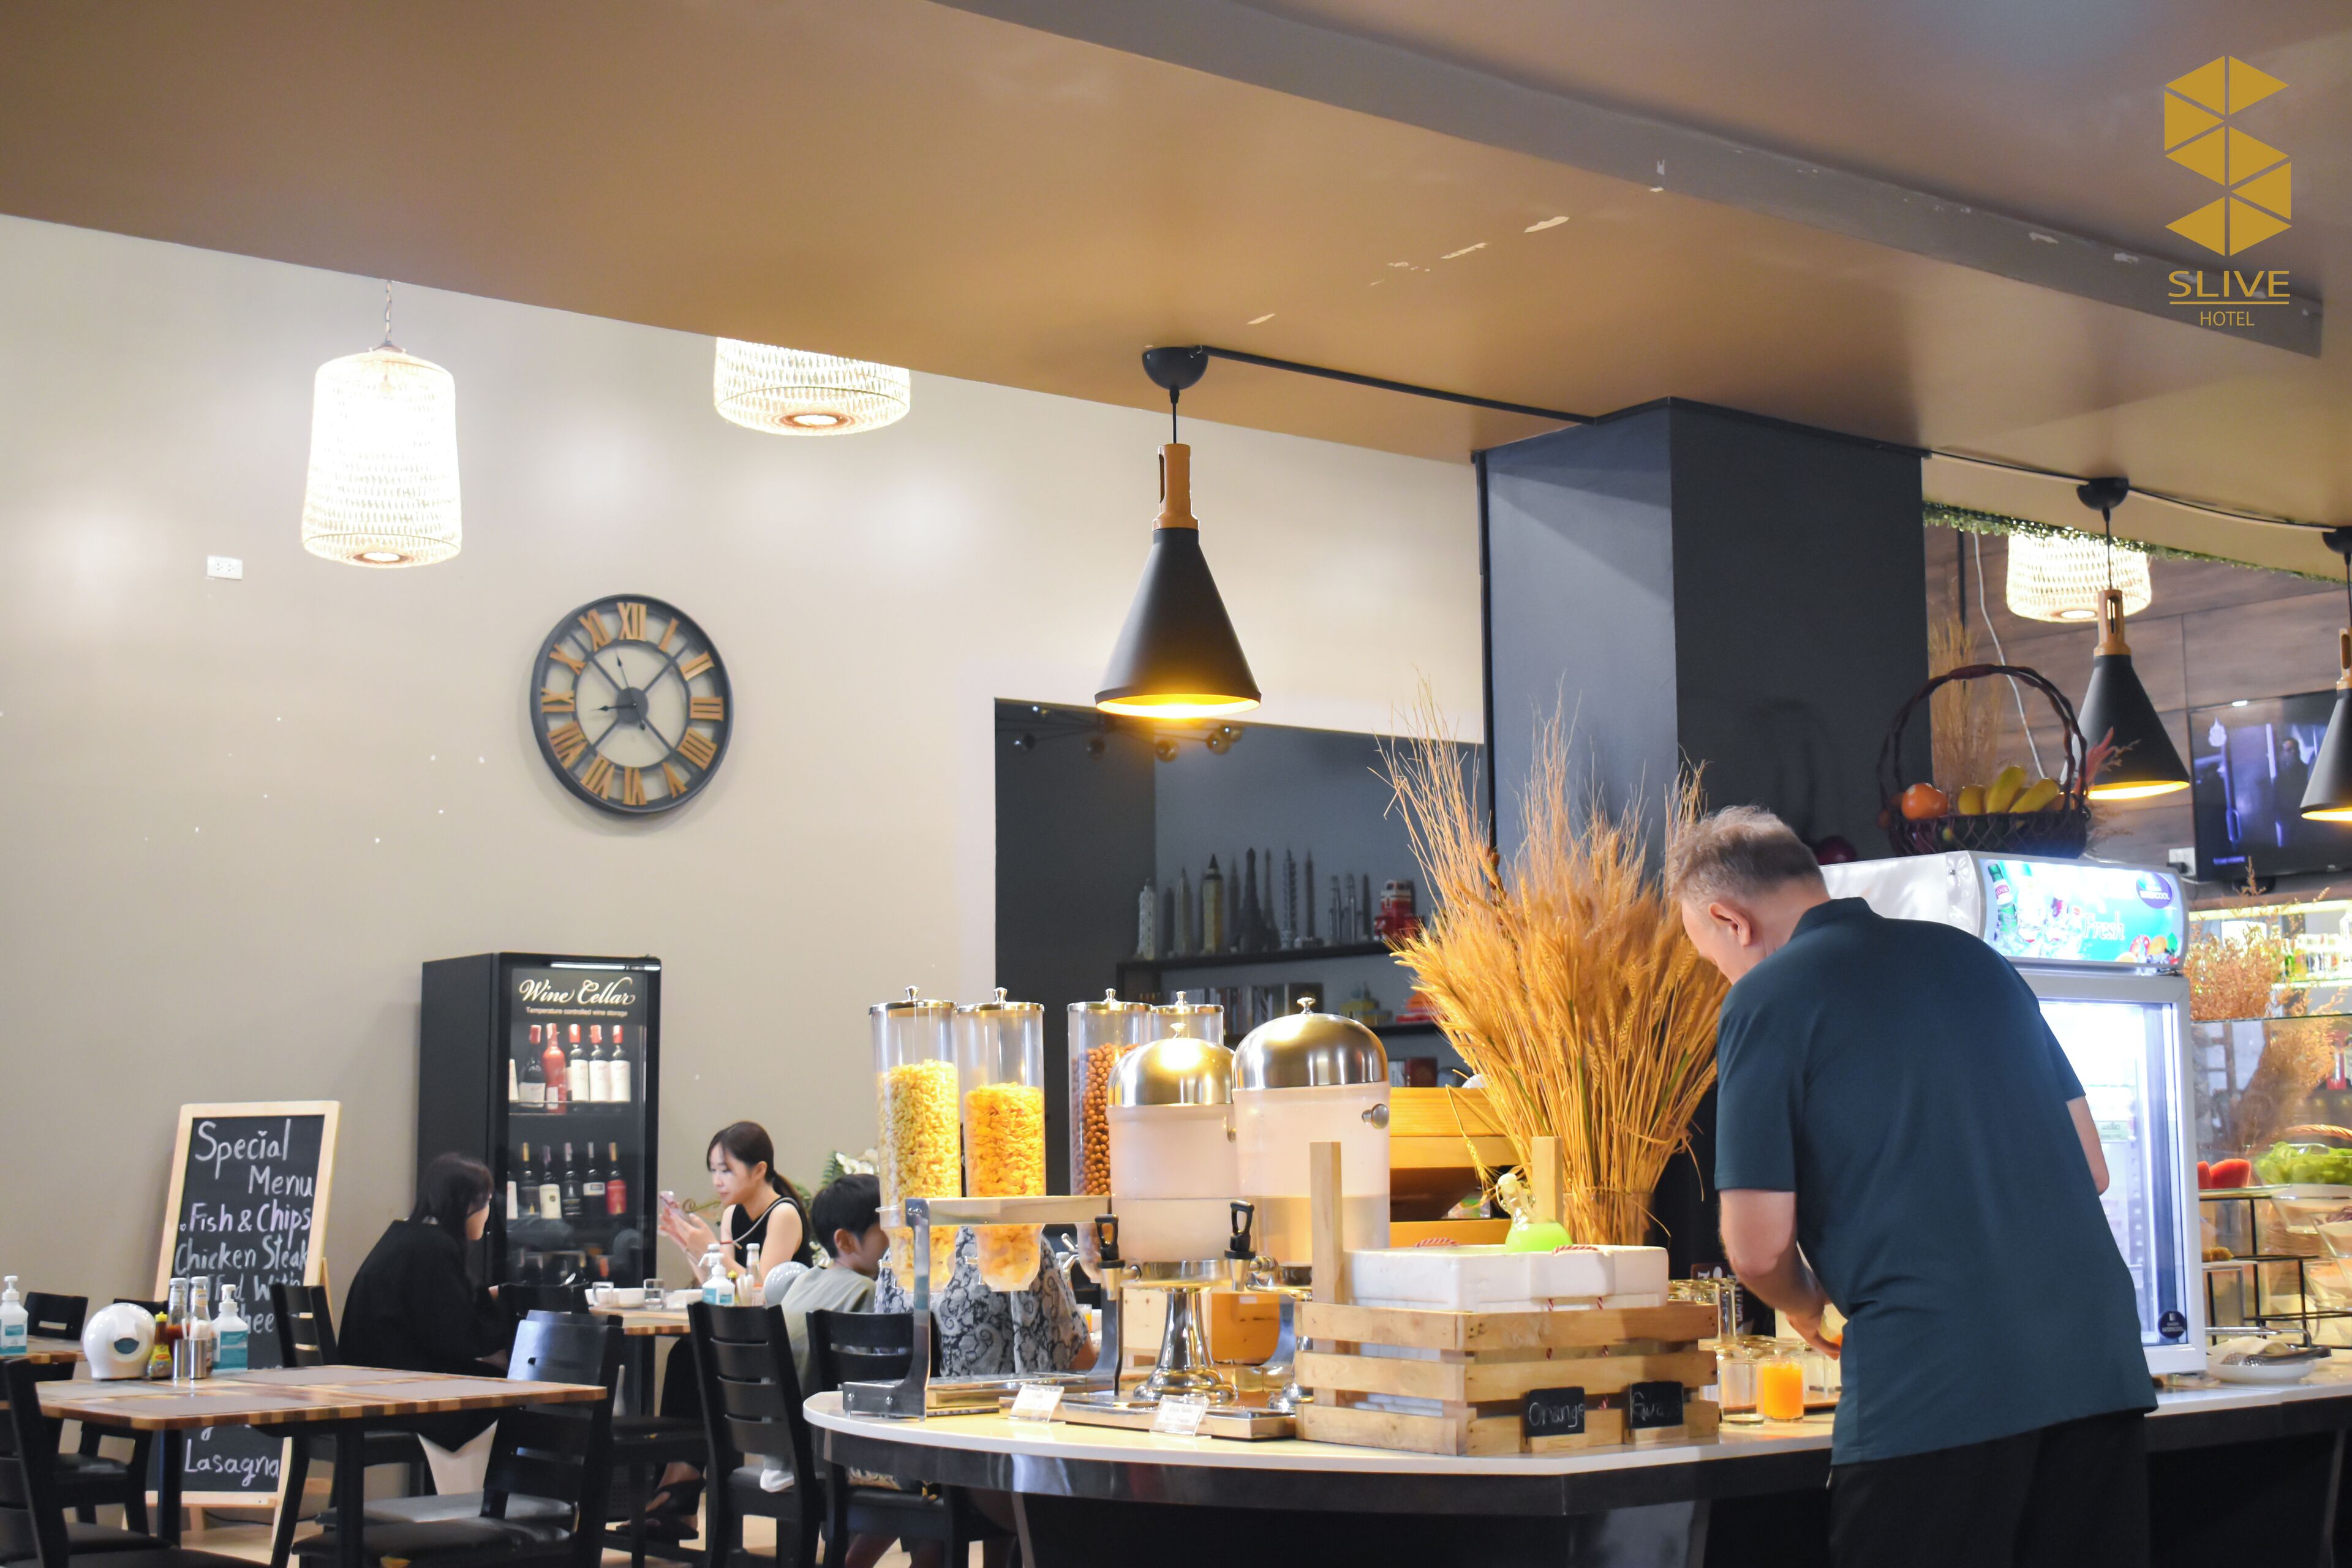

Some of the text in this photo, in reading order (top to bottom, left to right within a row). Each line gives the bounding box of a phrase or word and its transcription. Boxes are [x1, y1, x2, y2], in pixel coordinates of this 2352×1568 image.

[578, 609, 612, 652] XI
[617, 602, 647, 642] XII
[549, 643, 586, 675] X
[2083, 911, 2125, 940] Fresh
[519, 976, 636, 1005] Wine Cellar
[195, 1118, 292, 1180] Special
[248, 1165, 313, 1197] Menu
[189, 1199, 312, 1250] Fish & Chips
[175, 1234, 307, 1275] Chicken Steak
[1529, 1402, 1585, 1428] Orange
[184, 1439, 279, 1487] Lasagna
